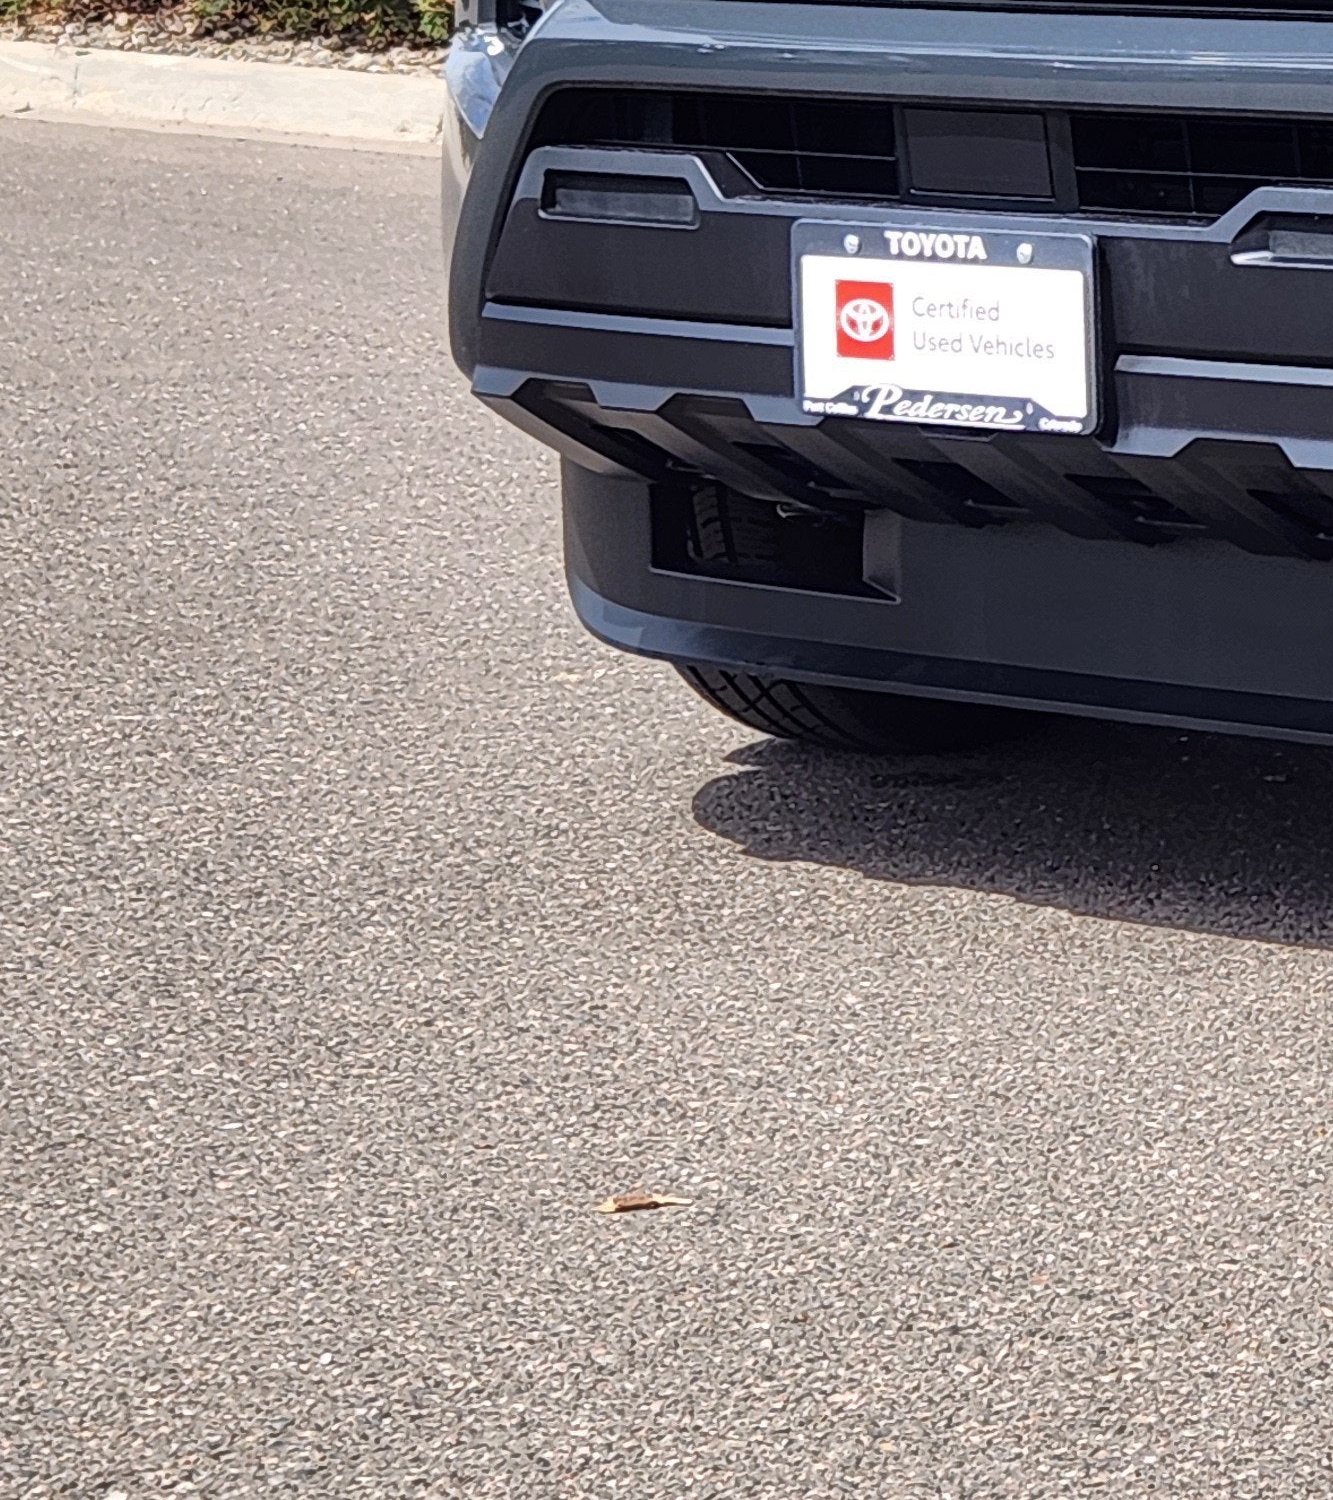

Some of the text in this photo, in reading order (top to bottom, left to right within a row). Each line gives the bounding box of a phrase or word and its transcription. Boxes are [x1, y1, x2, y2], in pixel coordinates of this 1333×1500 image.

[883, 230, 988, 260] TOYOTA
[912, 296, 1000, 322] Certified
[912, 331, 1056, 360] Used Vehicles
[861, 383, 1024, 425] Pedersen
